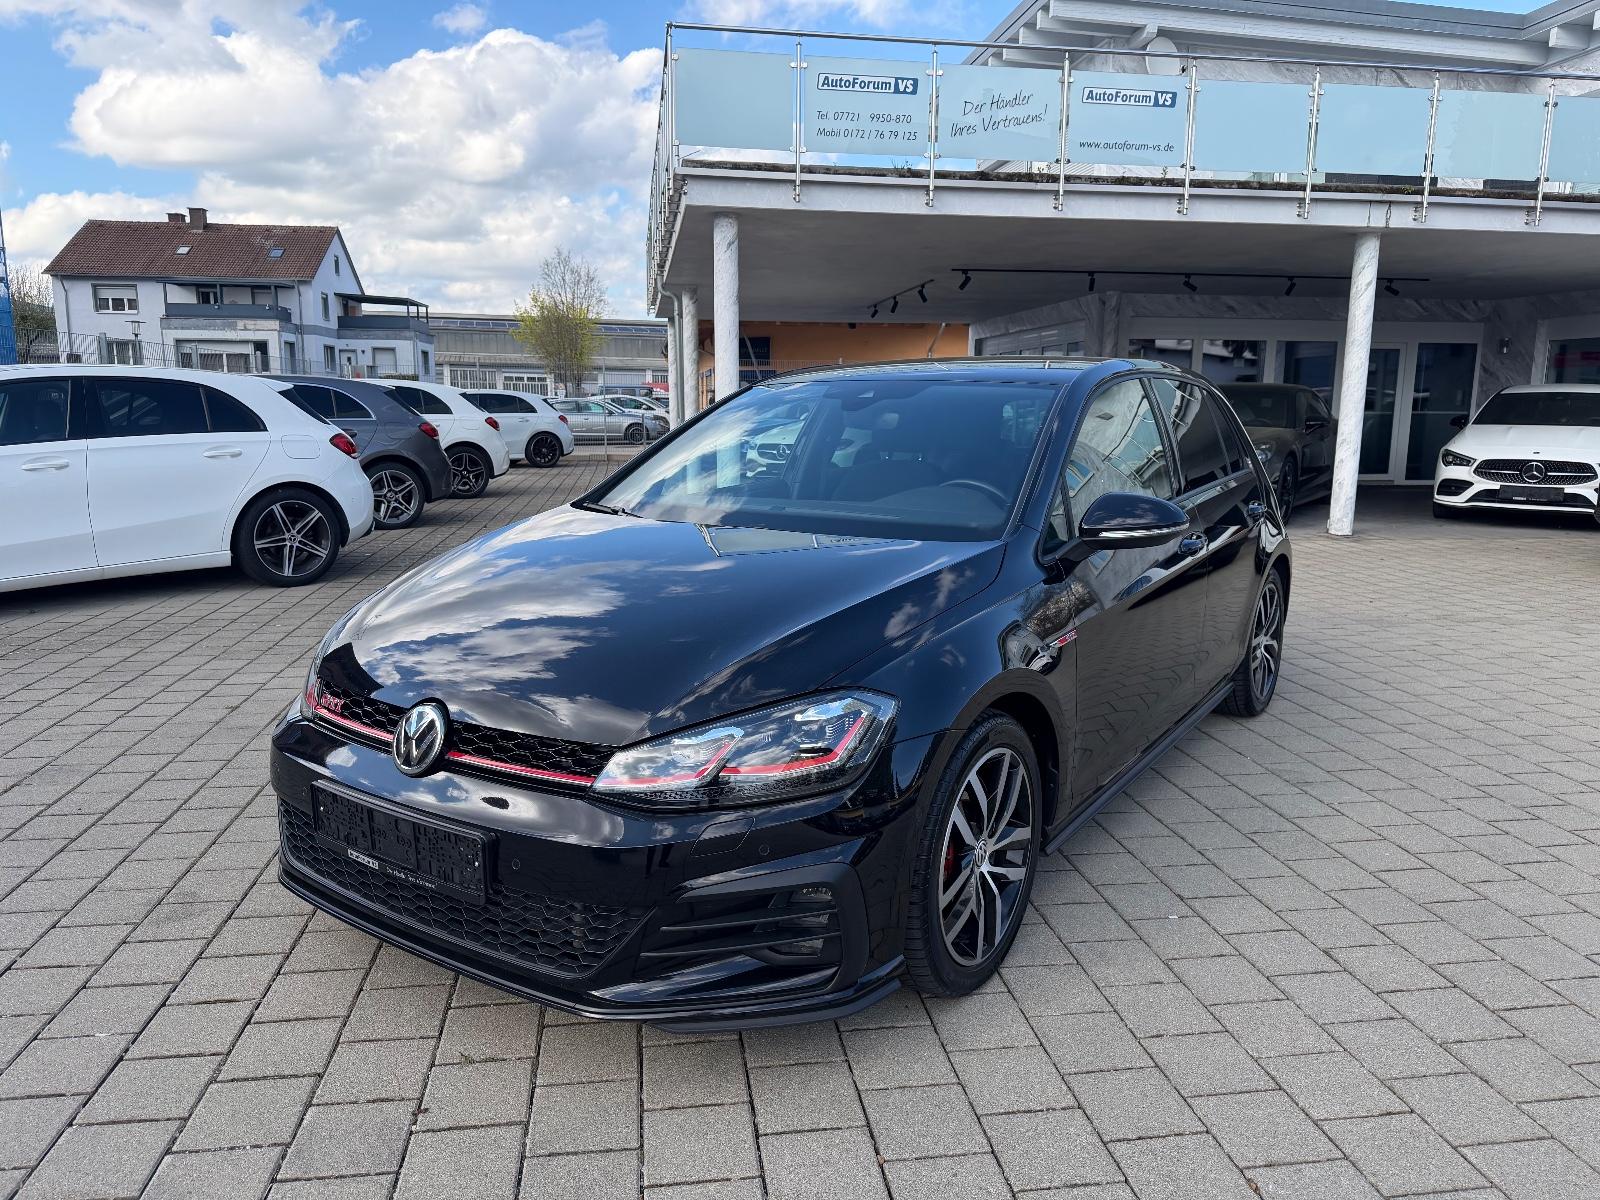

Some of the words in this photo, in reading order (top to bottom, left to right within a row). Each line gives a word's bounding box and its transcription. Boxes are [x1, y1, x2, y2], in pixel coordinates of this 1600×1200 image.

[820, 75, 892, 91] AutoForum
[897, 79, 914, 93] VS
[961, 100, 986, 117] Der
[990, 89, 1033, 111] Händler
[1085, 89, 1152, 104] AutoForum
[1157, 92, 1173, 106] VS
[816, 110, 830, 121] Tel.
[833, 111, 860, 122] 07721
[869, 113, 912, 124] 9950-870
[950, 122, 977, 137] Ihres
[982, 103, 1048, 132] Vertrauens!
[816, 127, 841, 138] Mobil
[843, 128, 865, 139] 0172
[874, 129, 885, 140] 76
[888, 130, 899, 140] 79
[902, 131, 918, 141] 125
[1079, 140, 1175, 152] www.autoforum-vs.de
